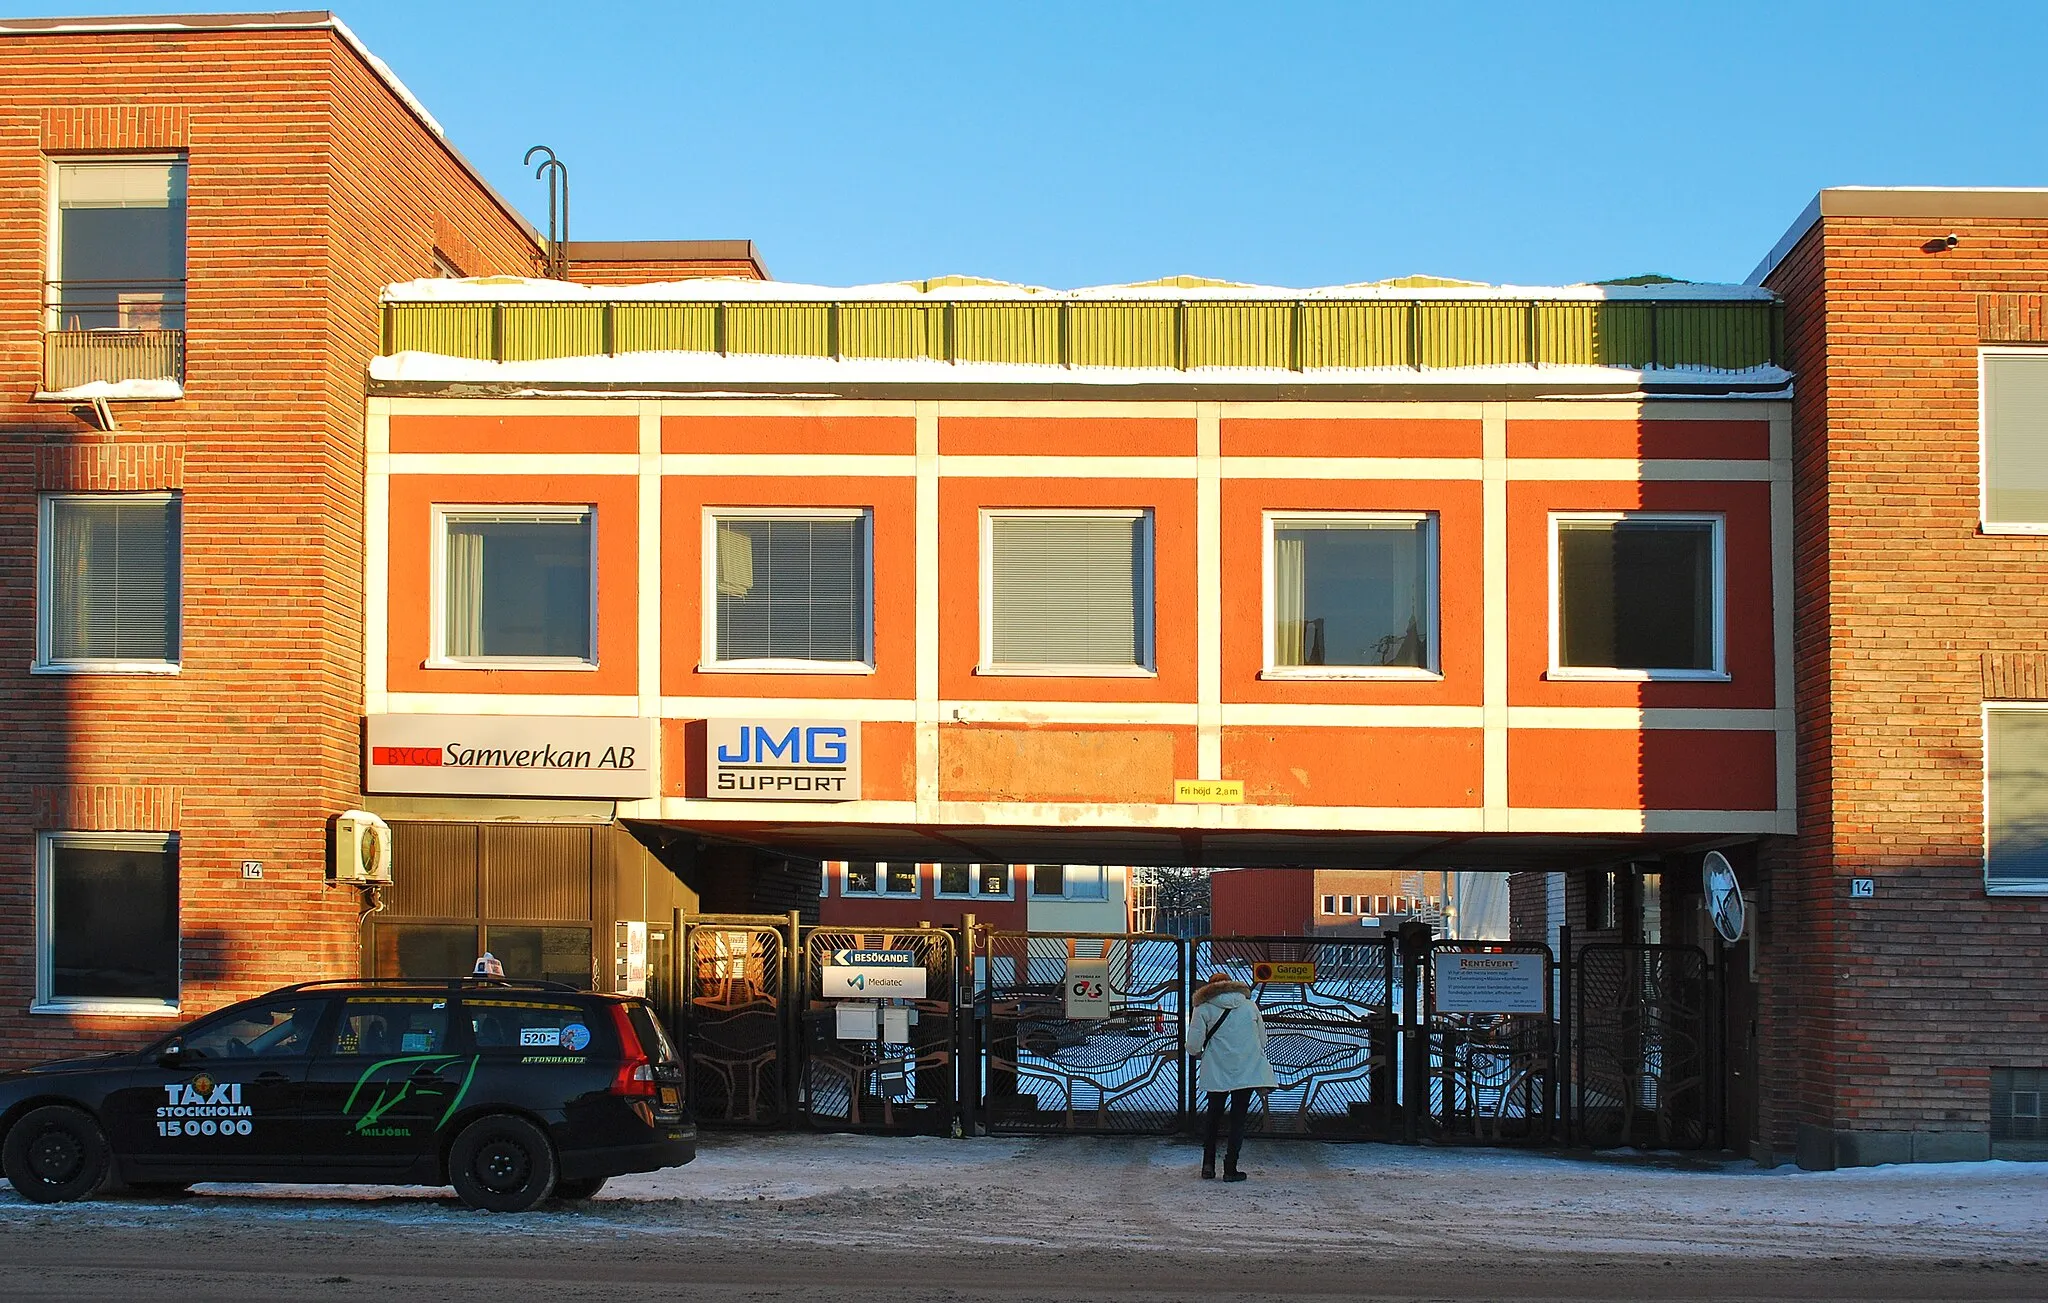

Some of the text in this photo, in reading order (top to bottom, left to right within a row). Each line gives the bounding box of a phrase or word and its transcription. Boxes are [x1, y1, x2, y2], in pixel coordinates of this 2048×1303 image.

[718, 726, 847, 763] JMG
[387, 742, 636, 769] BYGG Samverkan AB
[718, 773, 846, 791] SUPPORT
[1180, 786, 1191, 795] Fri
[1193, 786, 1211, 797] höjd
[245, 863, 261, 877] 14
[1855, 880, 1872, 895] 14
[854, 952, 909, 963] BESÖKANDE
[1277, 964, 1308, 975] Garage
[868, 978, 903, 987] Mediatec
[164, 1083, 242, 1105] TAXI
[156, 1105, 252, 1117] STOCKHOLM
[361, 1126, 411, 1137] MILJÖBIL
